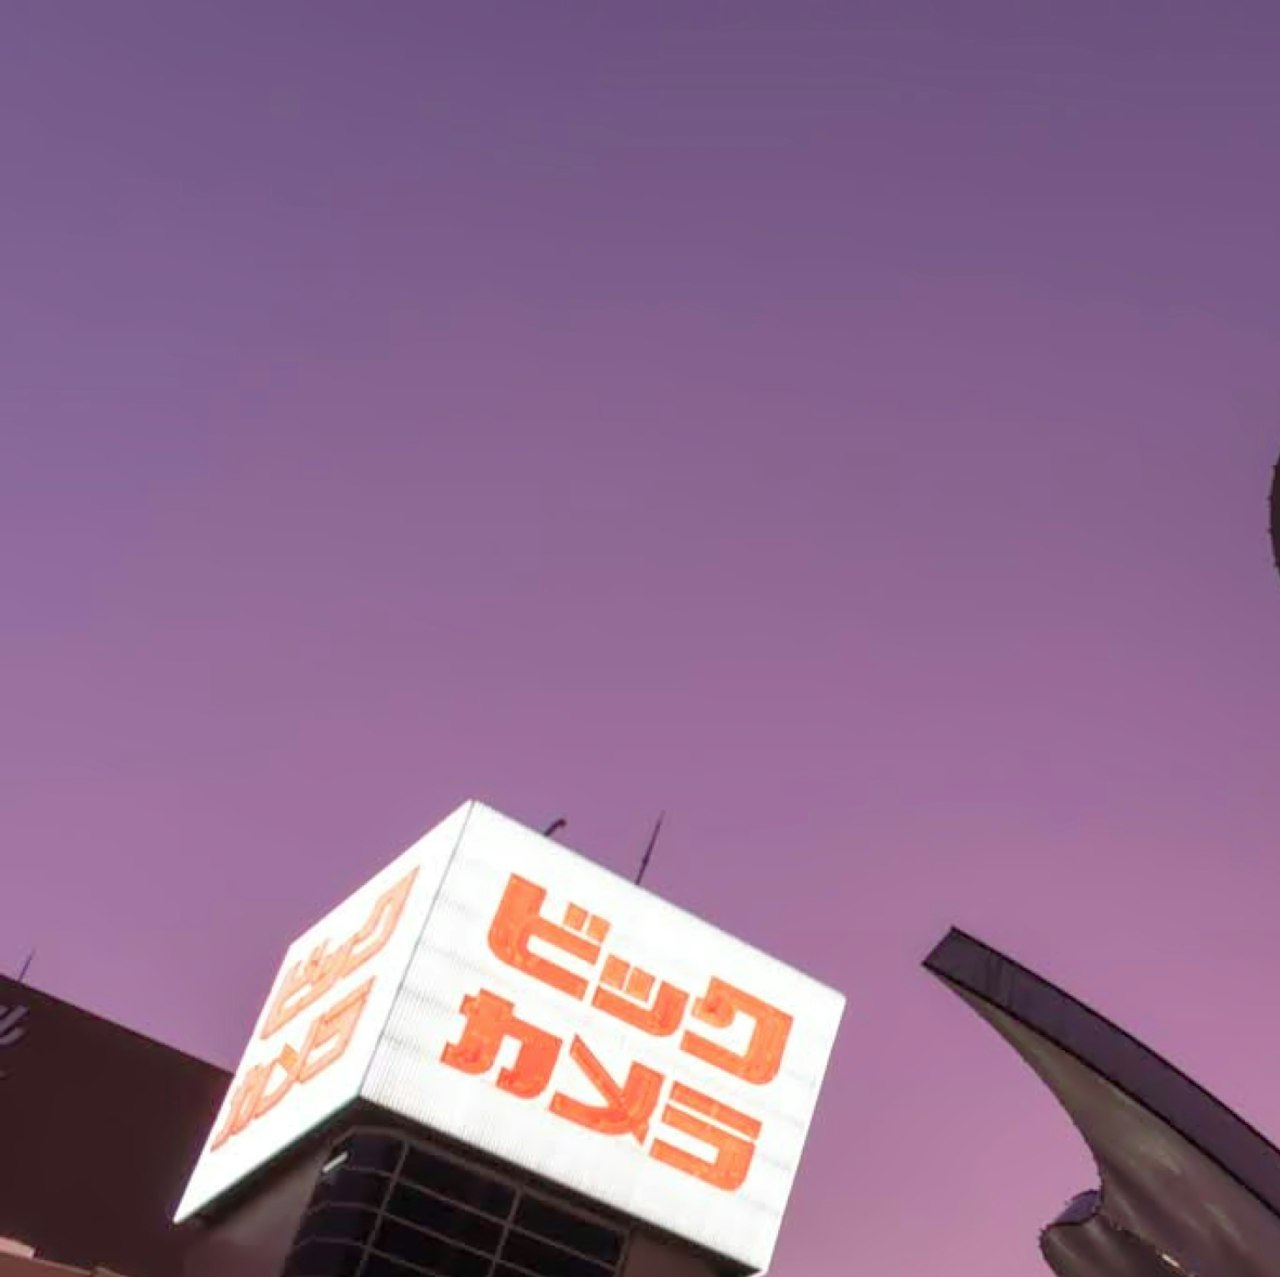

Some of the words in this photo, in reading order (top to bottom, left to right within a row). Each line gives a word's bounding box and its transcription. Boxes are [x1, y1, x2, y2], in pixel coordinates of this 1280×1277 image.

[487, 871, 794, 1086] ビック
[440, 988, 763, 1191] カメラ
